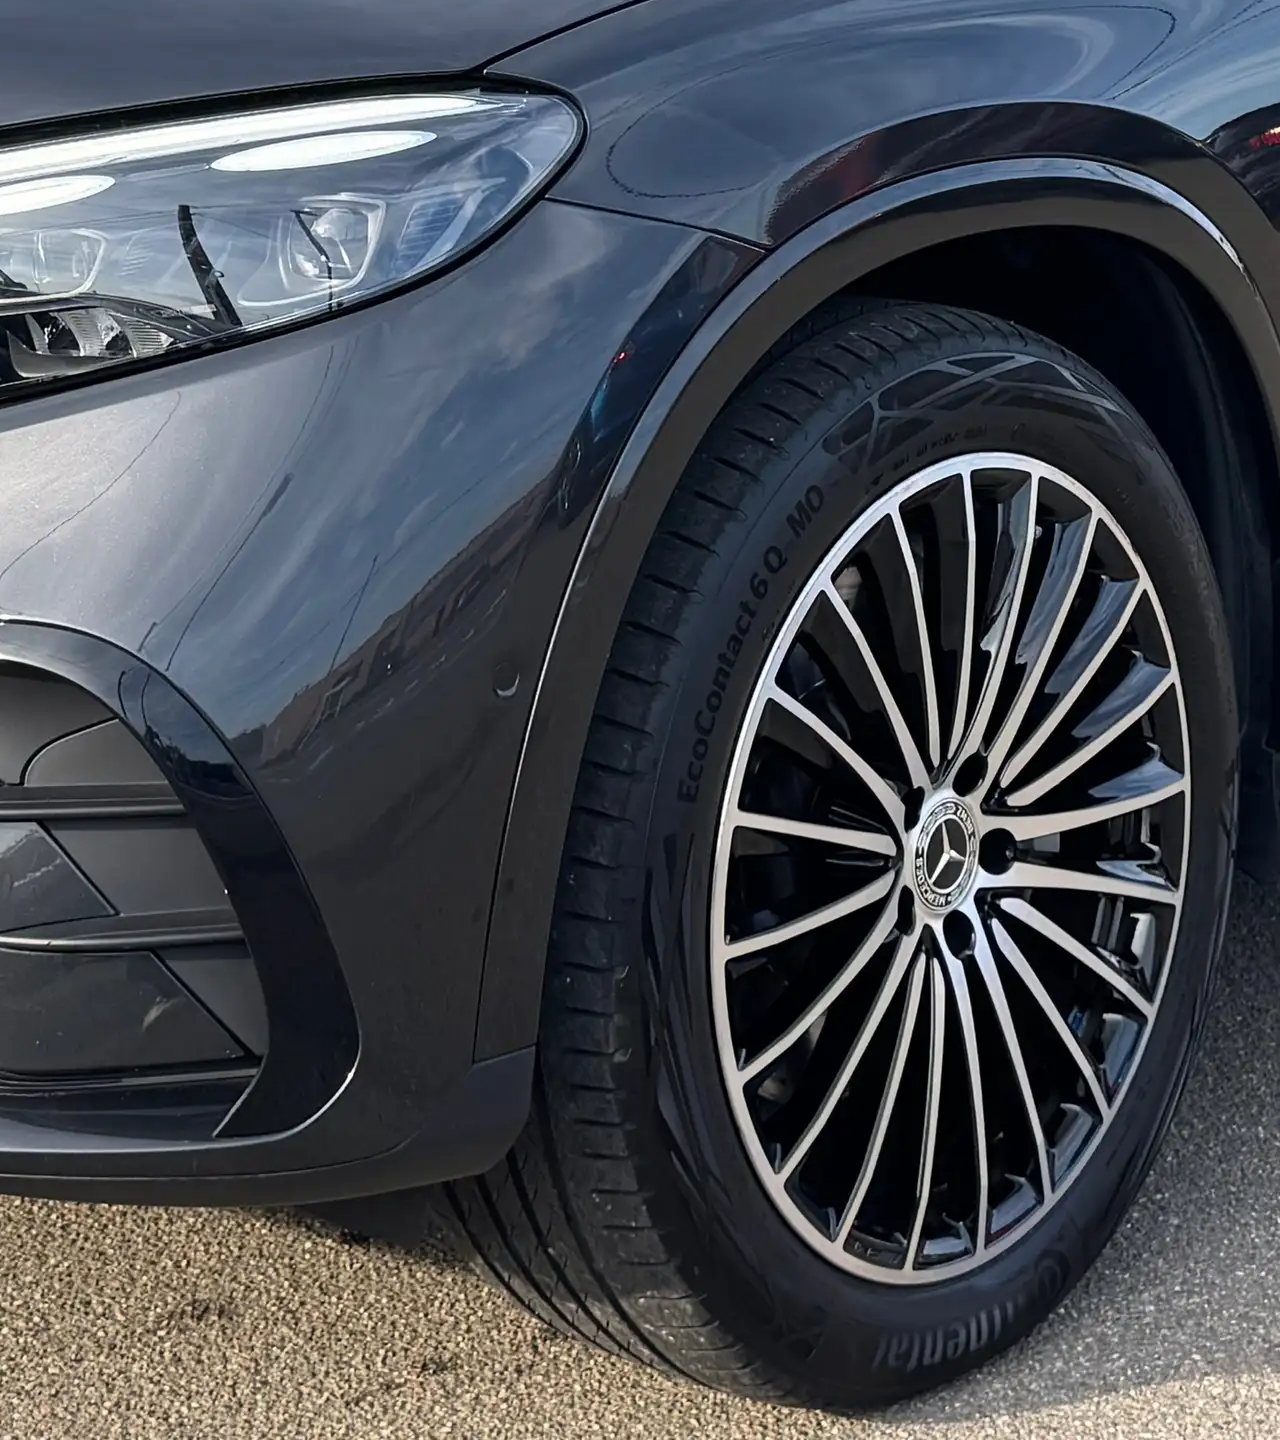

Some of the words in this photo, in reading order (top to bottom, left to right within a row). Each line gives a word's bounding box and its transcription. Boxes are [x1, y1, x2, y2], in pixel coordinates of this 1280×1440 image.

[677, 599, 757, 804] EcoContact
[749, 571, 769, 601] 6
[763, 545, 788, 574] Q
[786, 484, 825, 540] MO
